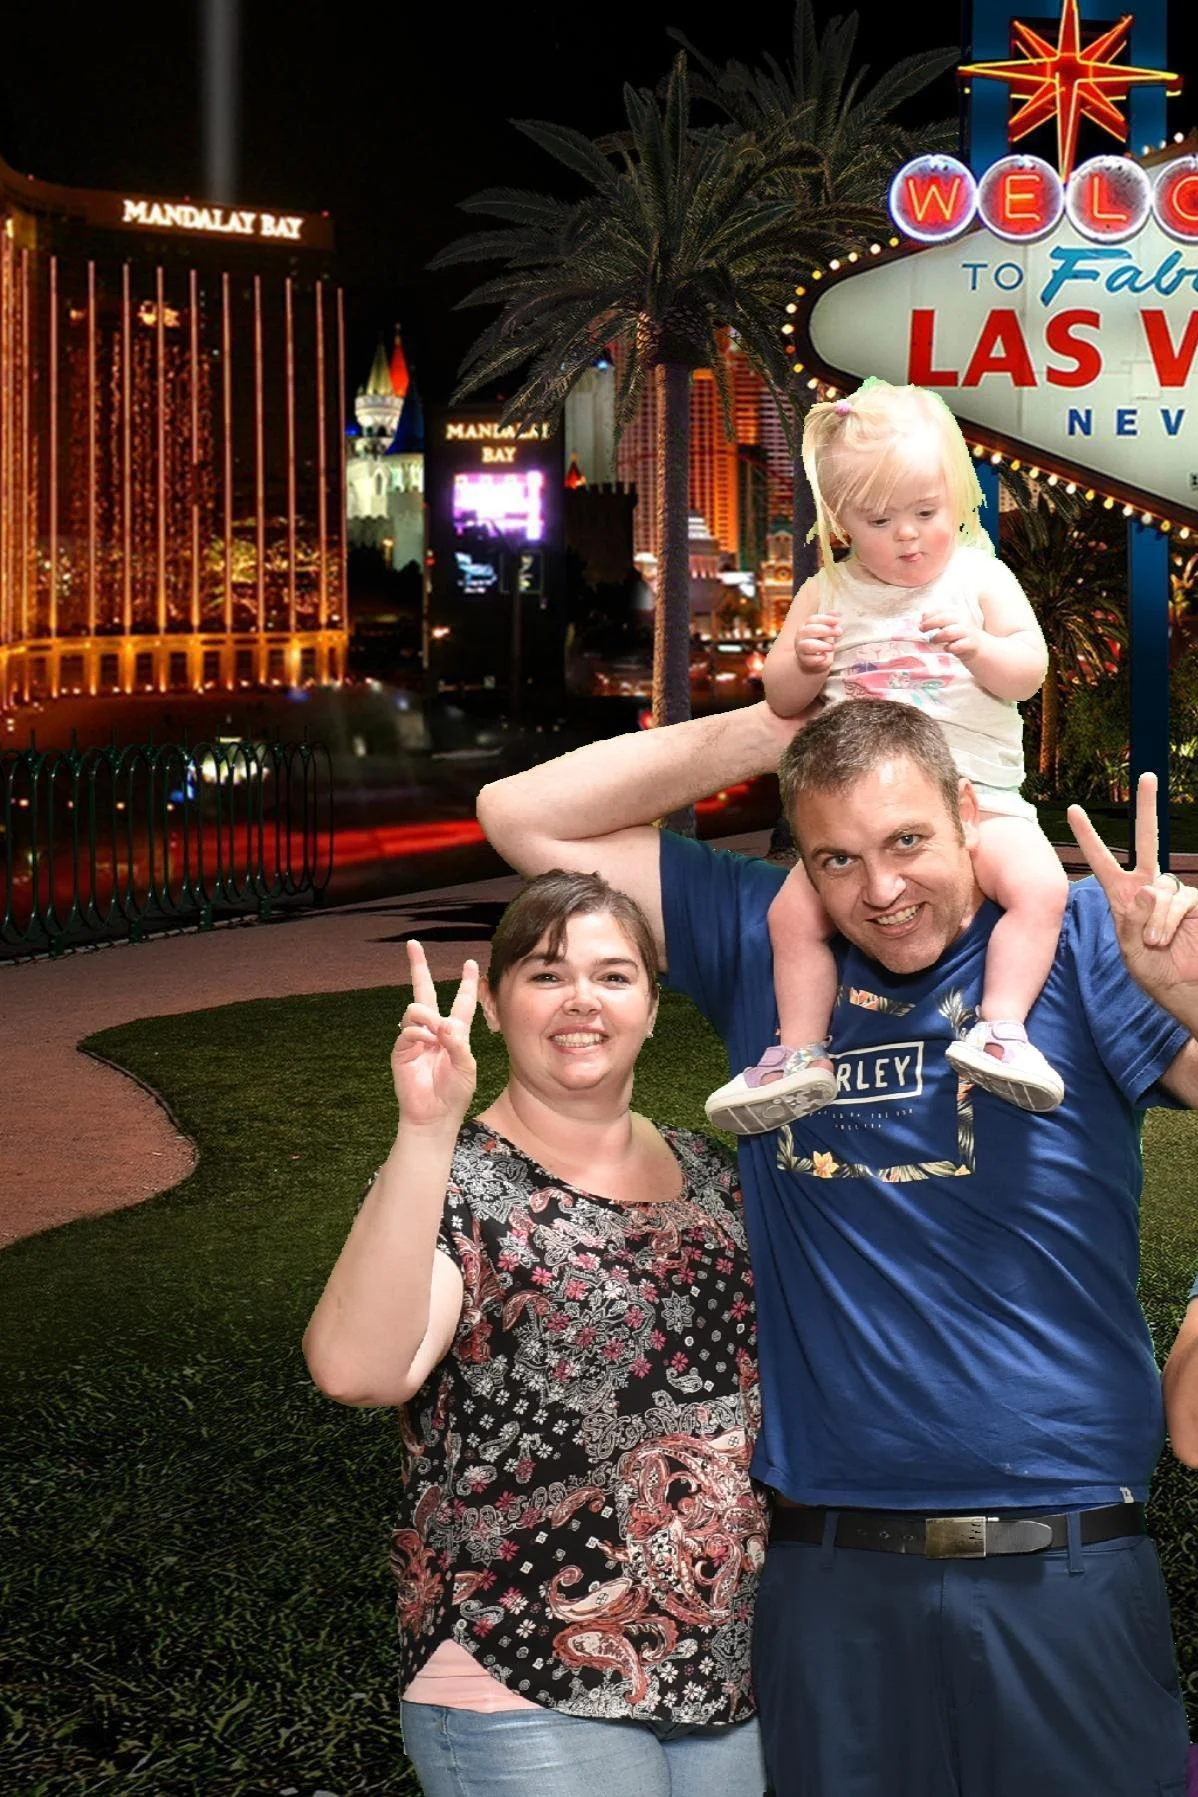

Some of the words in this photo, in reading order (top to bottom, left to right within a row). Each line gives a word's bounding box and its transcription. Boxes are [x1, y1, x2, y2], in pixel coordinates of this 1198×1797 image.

[122, 199, 257, 234] MANDALAY
[260, 213, 304, 239] BAY
[962, 263, 1024, 291] TO
[906, 308, 1101, 388] LAS
[481, 446, 517, 463] BAY
[836, 1055, 911, 1093] RLEY
